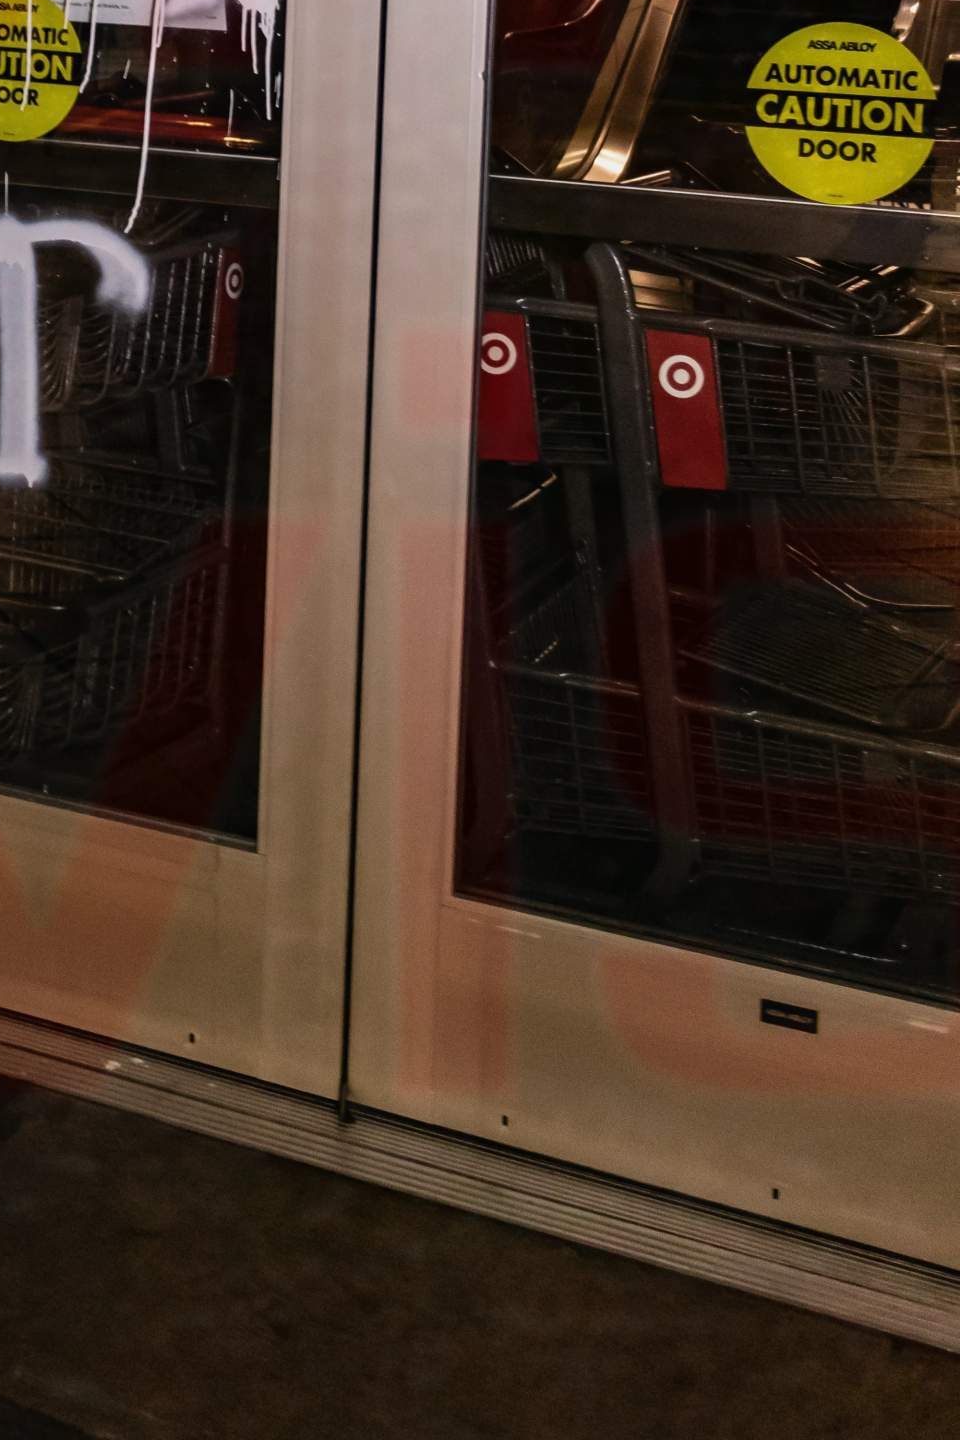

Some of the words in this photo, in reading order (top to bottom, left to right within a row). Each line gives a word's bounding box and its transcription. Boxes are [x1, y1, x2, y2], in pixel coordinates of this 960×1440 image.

[807, 39, 837, 50] ASSA
[765, 63, 919, 91] AUTOMATIC
[755, 93, 924, 133] CAUTION
[798, 137, 877, 163] DOOR
